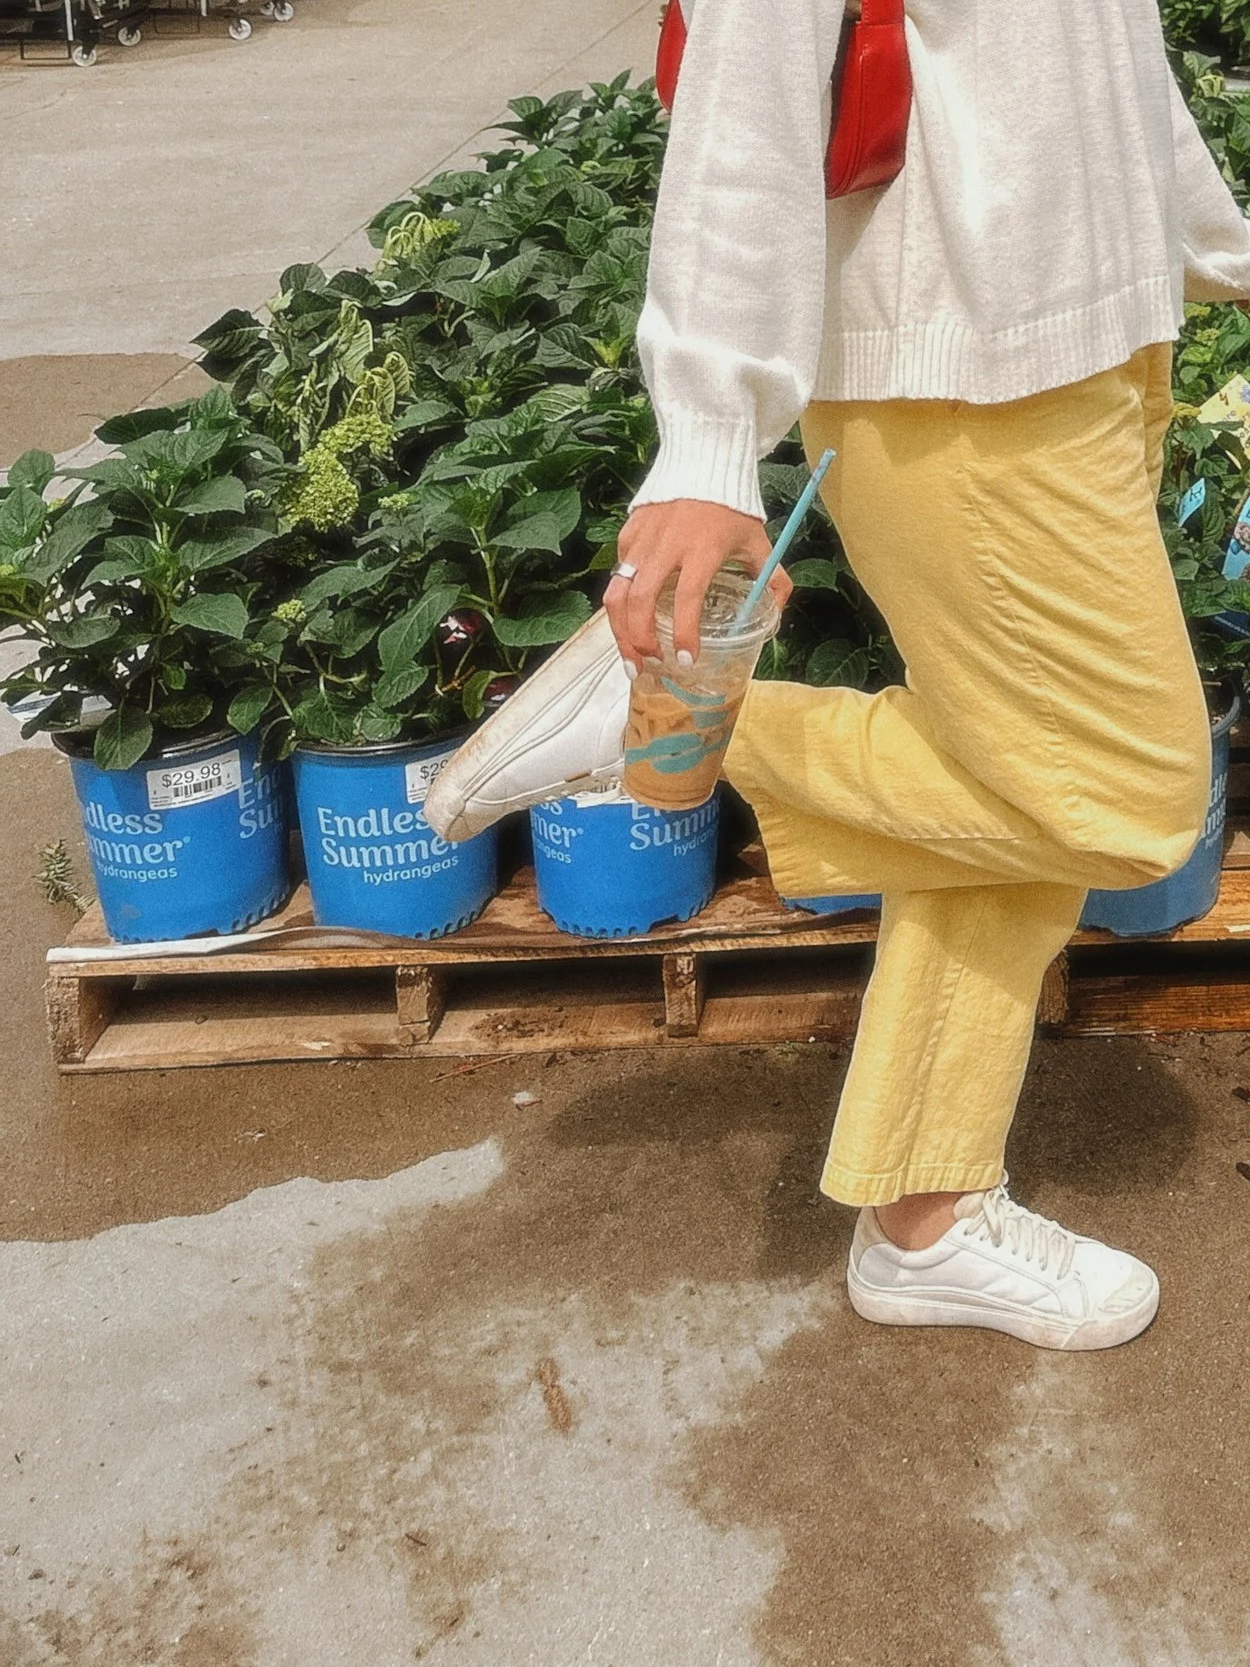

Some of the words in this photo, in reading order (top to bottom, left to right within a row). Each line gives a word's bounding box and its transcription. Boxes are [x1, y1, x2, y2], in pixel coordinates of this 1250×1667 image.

[161, 761, 222, 789] $29.98
[85, 801, 163, 835] dless
[317, 806, 431, 838] Endles
[88, 836, 182, 865] mmer
[363, 855, 459, 886] hydrangeas
